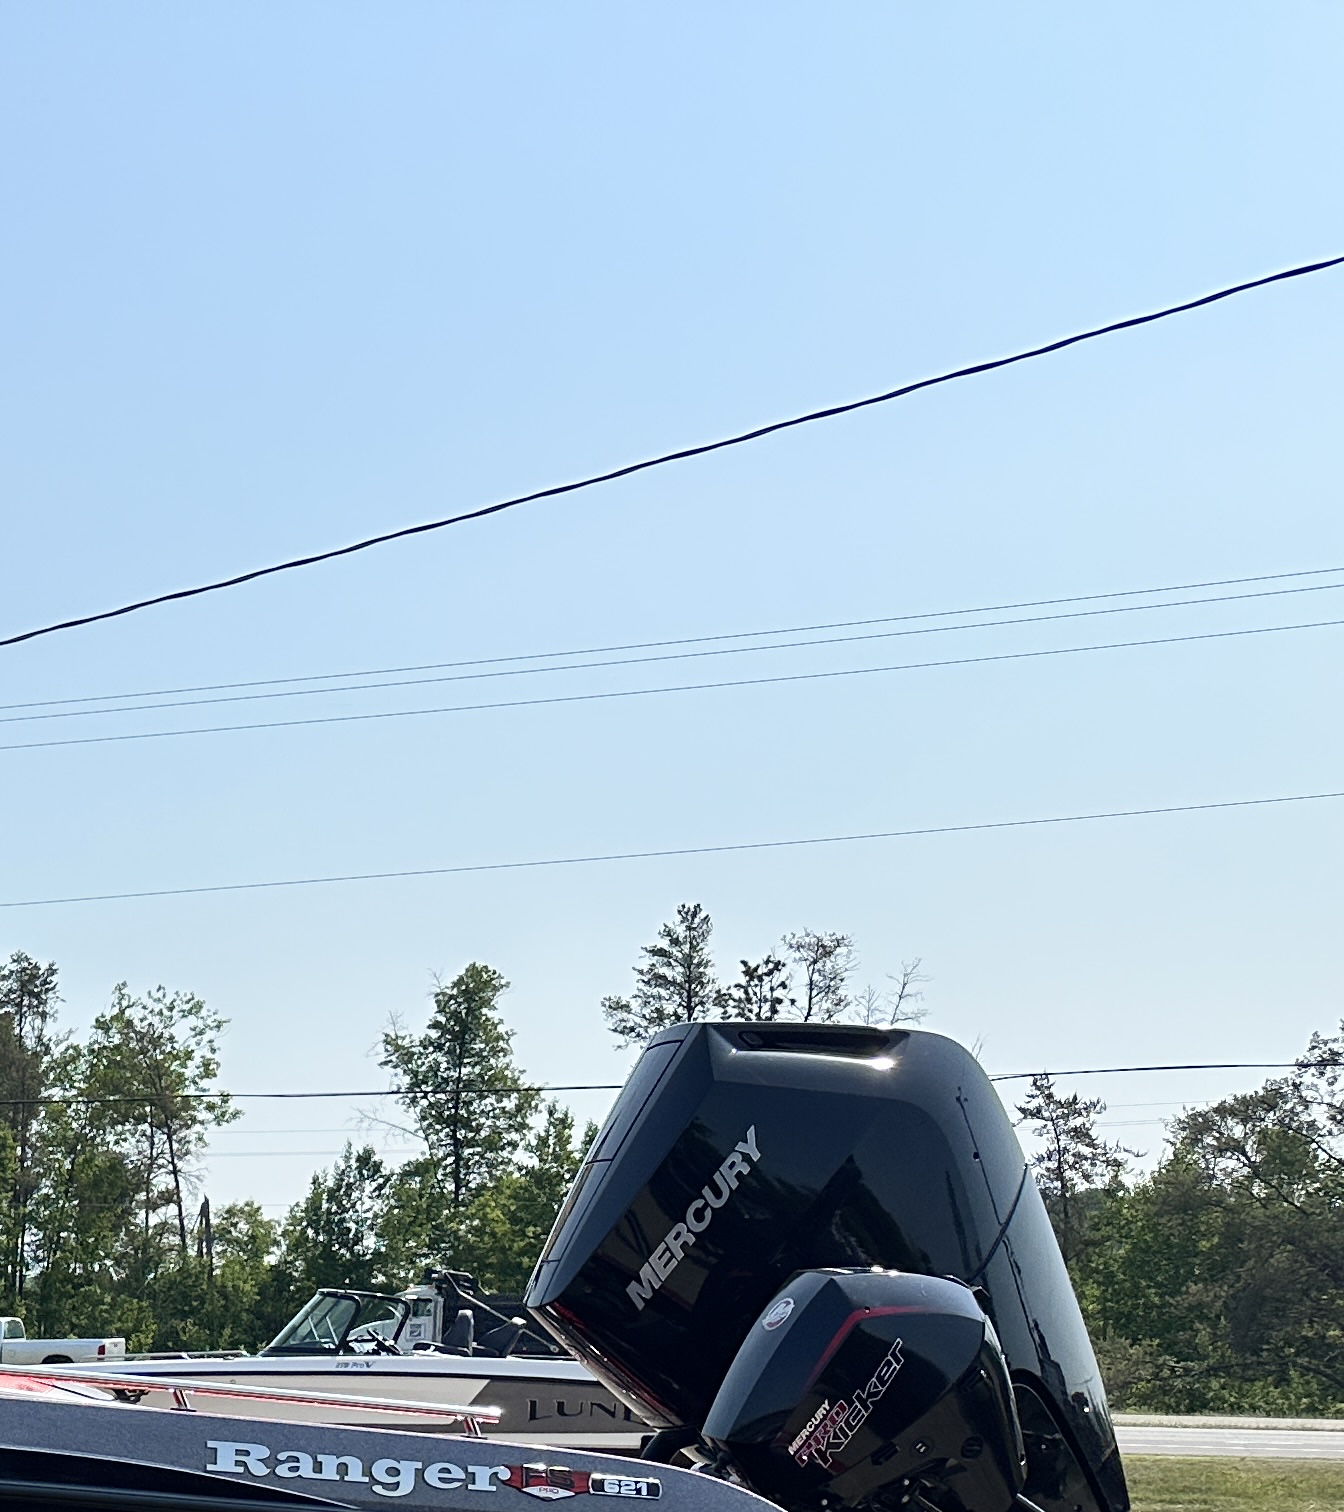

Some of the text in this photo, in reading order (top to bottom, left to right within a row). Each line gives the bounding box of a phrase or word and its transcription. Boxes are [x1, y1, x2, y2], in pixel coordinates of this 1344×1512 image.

[626, 1124, 761, 1311] MERCURY
[788, 1398, 831, 1456] MERCURY
[206, 1440, 512, 1497] Ranger
[603, 1479, 648, 1496] 621
